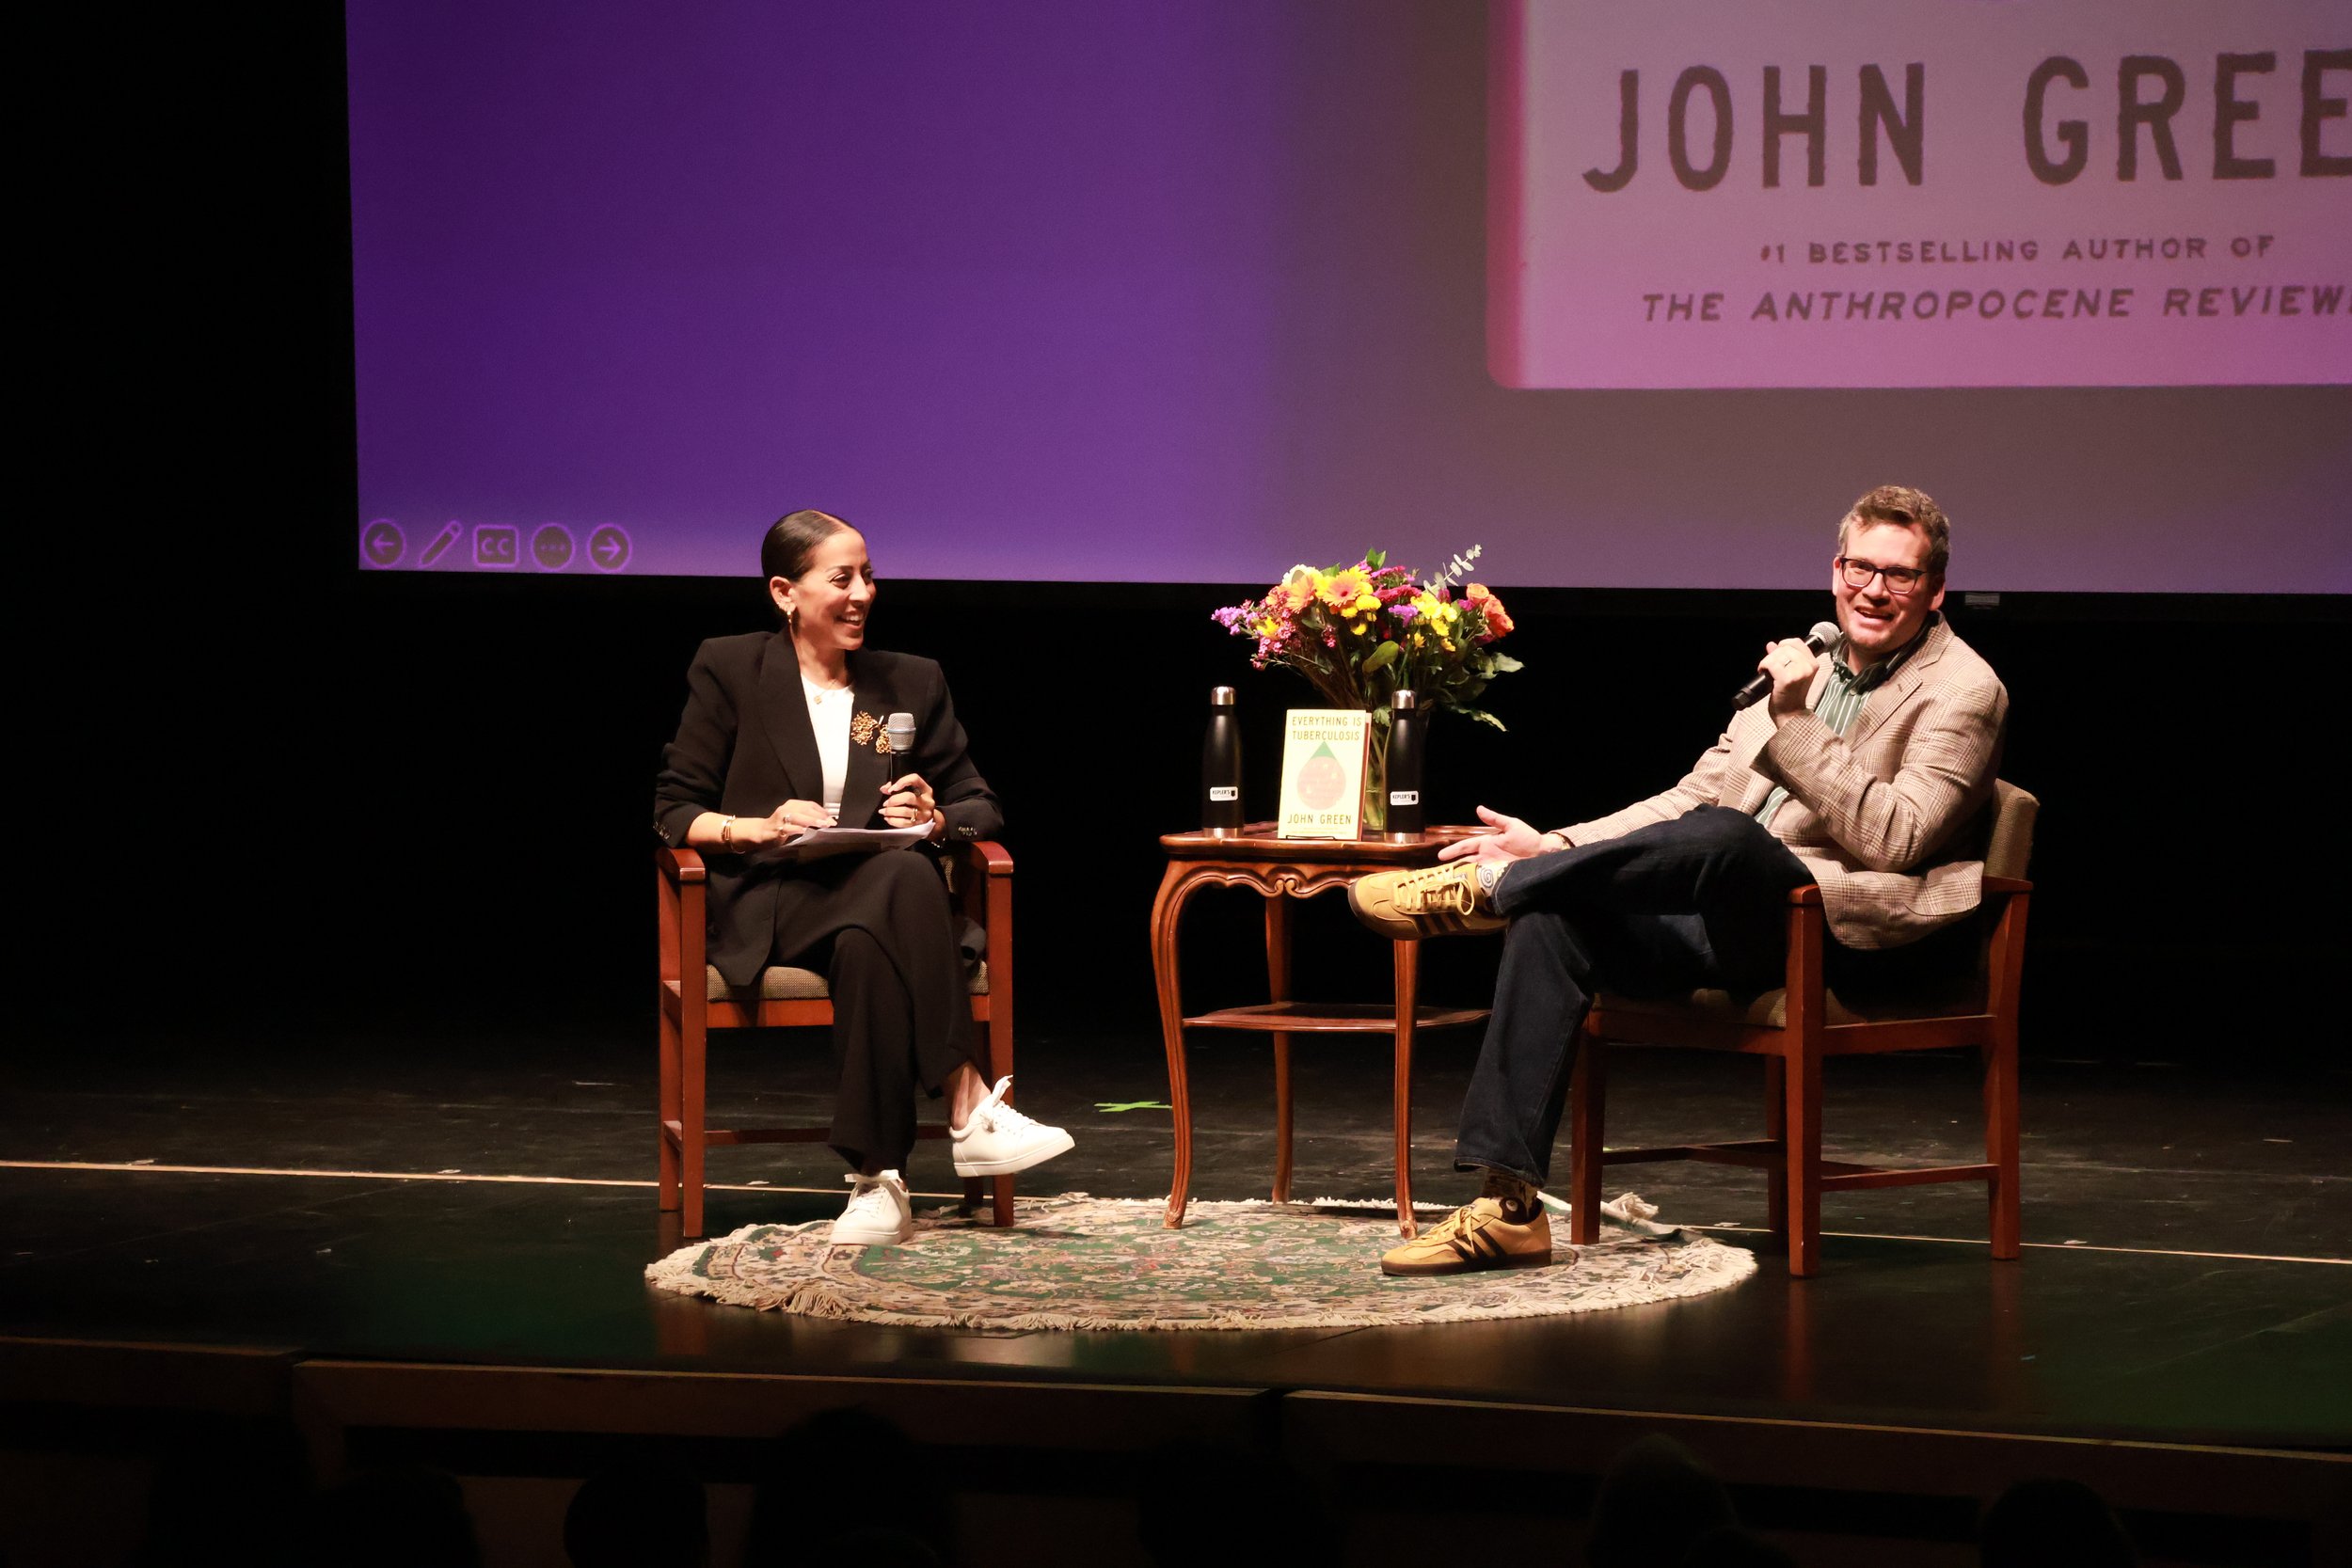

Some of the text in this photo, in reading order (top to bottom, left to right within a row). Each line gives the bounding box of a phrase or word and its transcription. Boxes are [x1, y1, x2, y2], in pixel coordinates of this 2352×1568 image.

[1581, 49, 2352, 193] JOHN GREE
[1760, 234, 2275, 264] #1 BESTSELLING AUTHOR OF
[1642, 284, 2352, 322] THE ANTHROPOCENE REVIEW
[481, 537, 510, 556] CC
[1292, 716, 1362, 728] EVERYTHING IS
[1292, 730, 1360, 741] TUBERCULOSIS
[1287, 814, 1352, 825] JOHN GREEN
